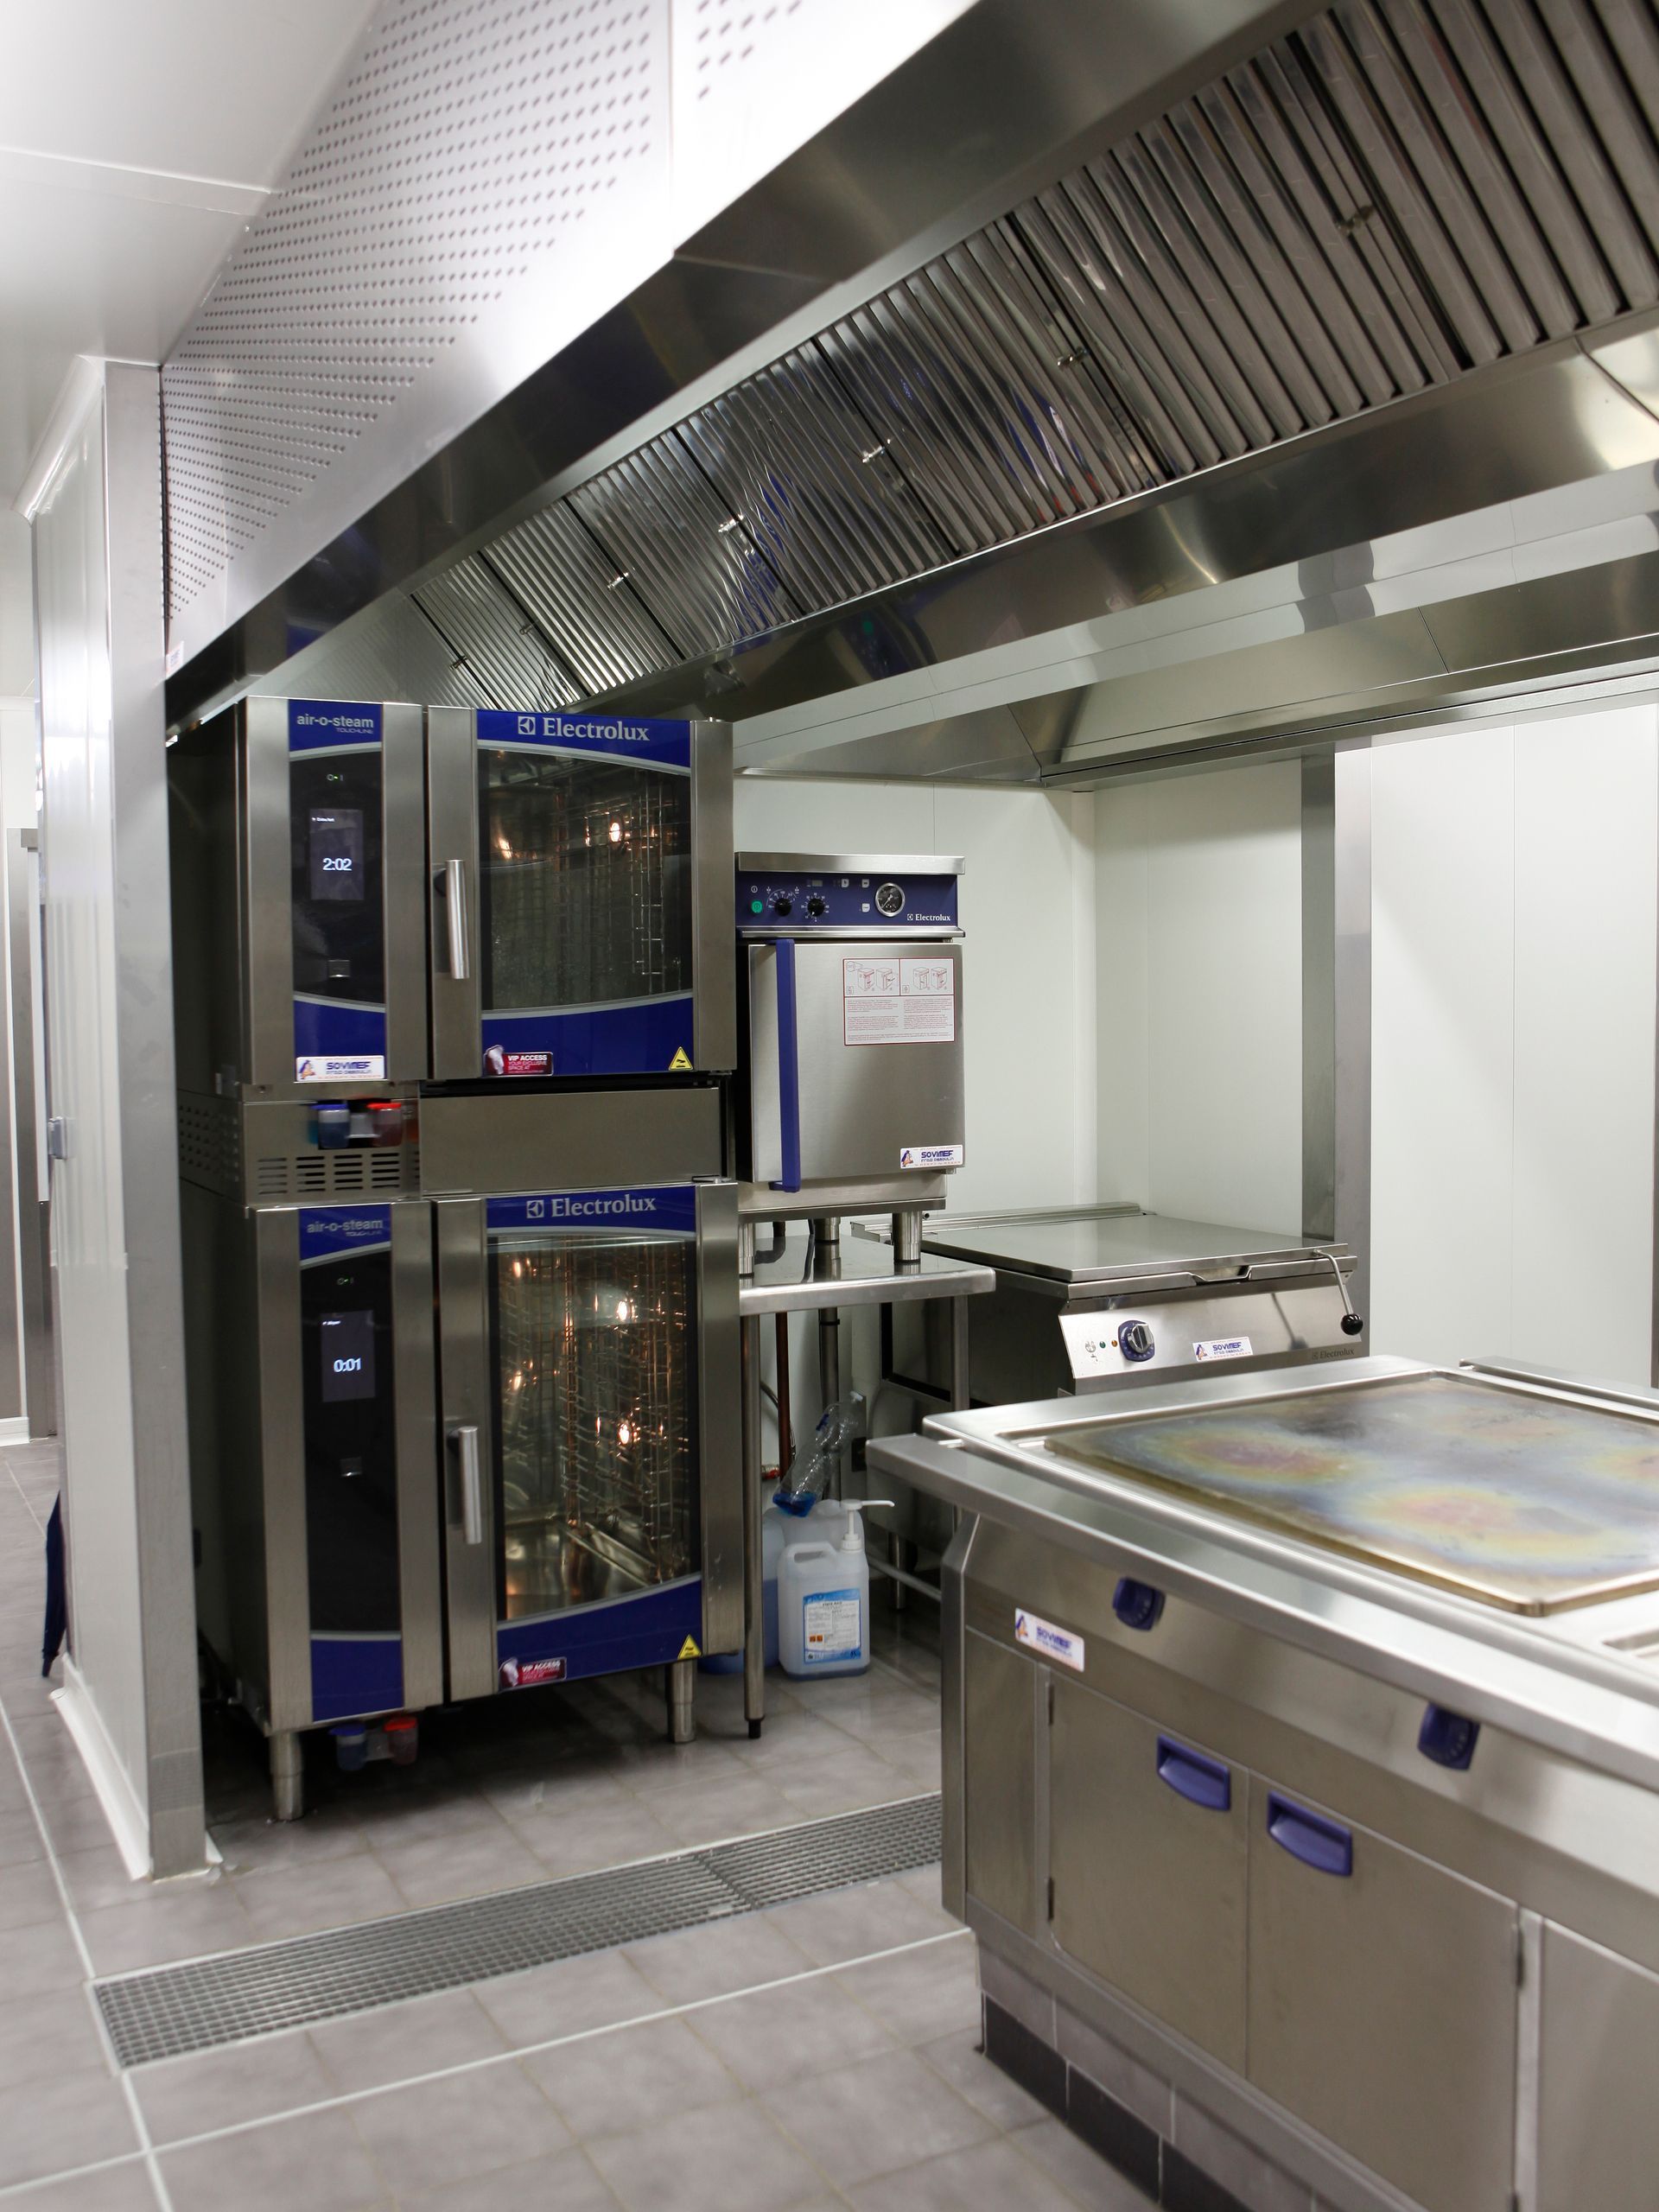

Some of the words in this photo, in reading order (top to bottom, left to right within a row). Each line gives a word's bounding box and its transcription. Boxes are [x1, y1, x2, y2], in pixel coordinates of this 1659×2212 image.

[296, 713, 373, 728] air-o-steam
[543, 717, 650, 741] Electrolux
[322, 857, 353, 871] 2:02
[551, 1194, 657, 1217] Electrolux
[307, 1219, 383, 1233] air-o-steam
[1319, 1346, 1355, 1359] Electrolux
[334, 1357, 361, 1372] 0:01
